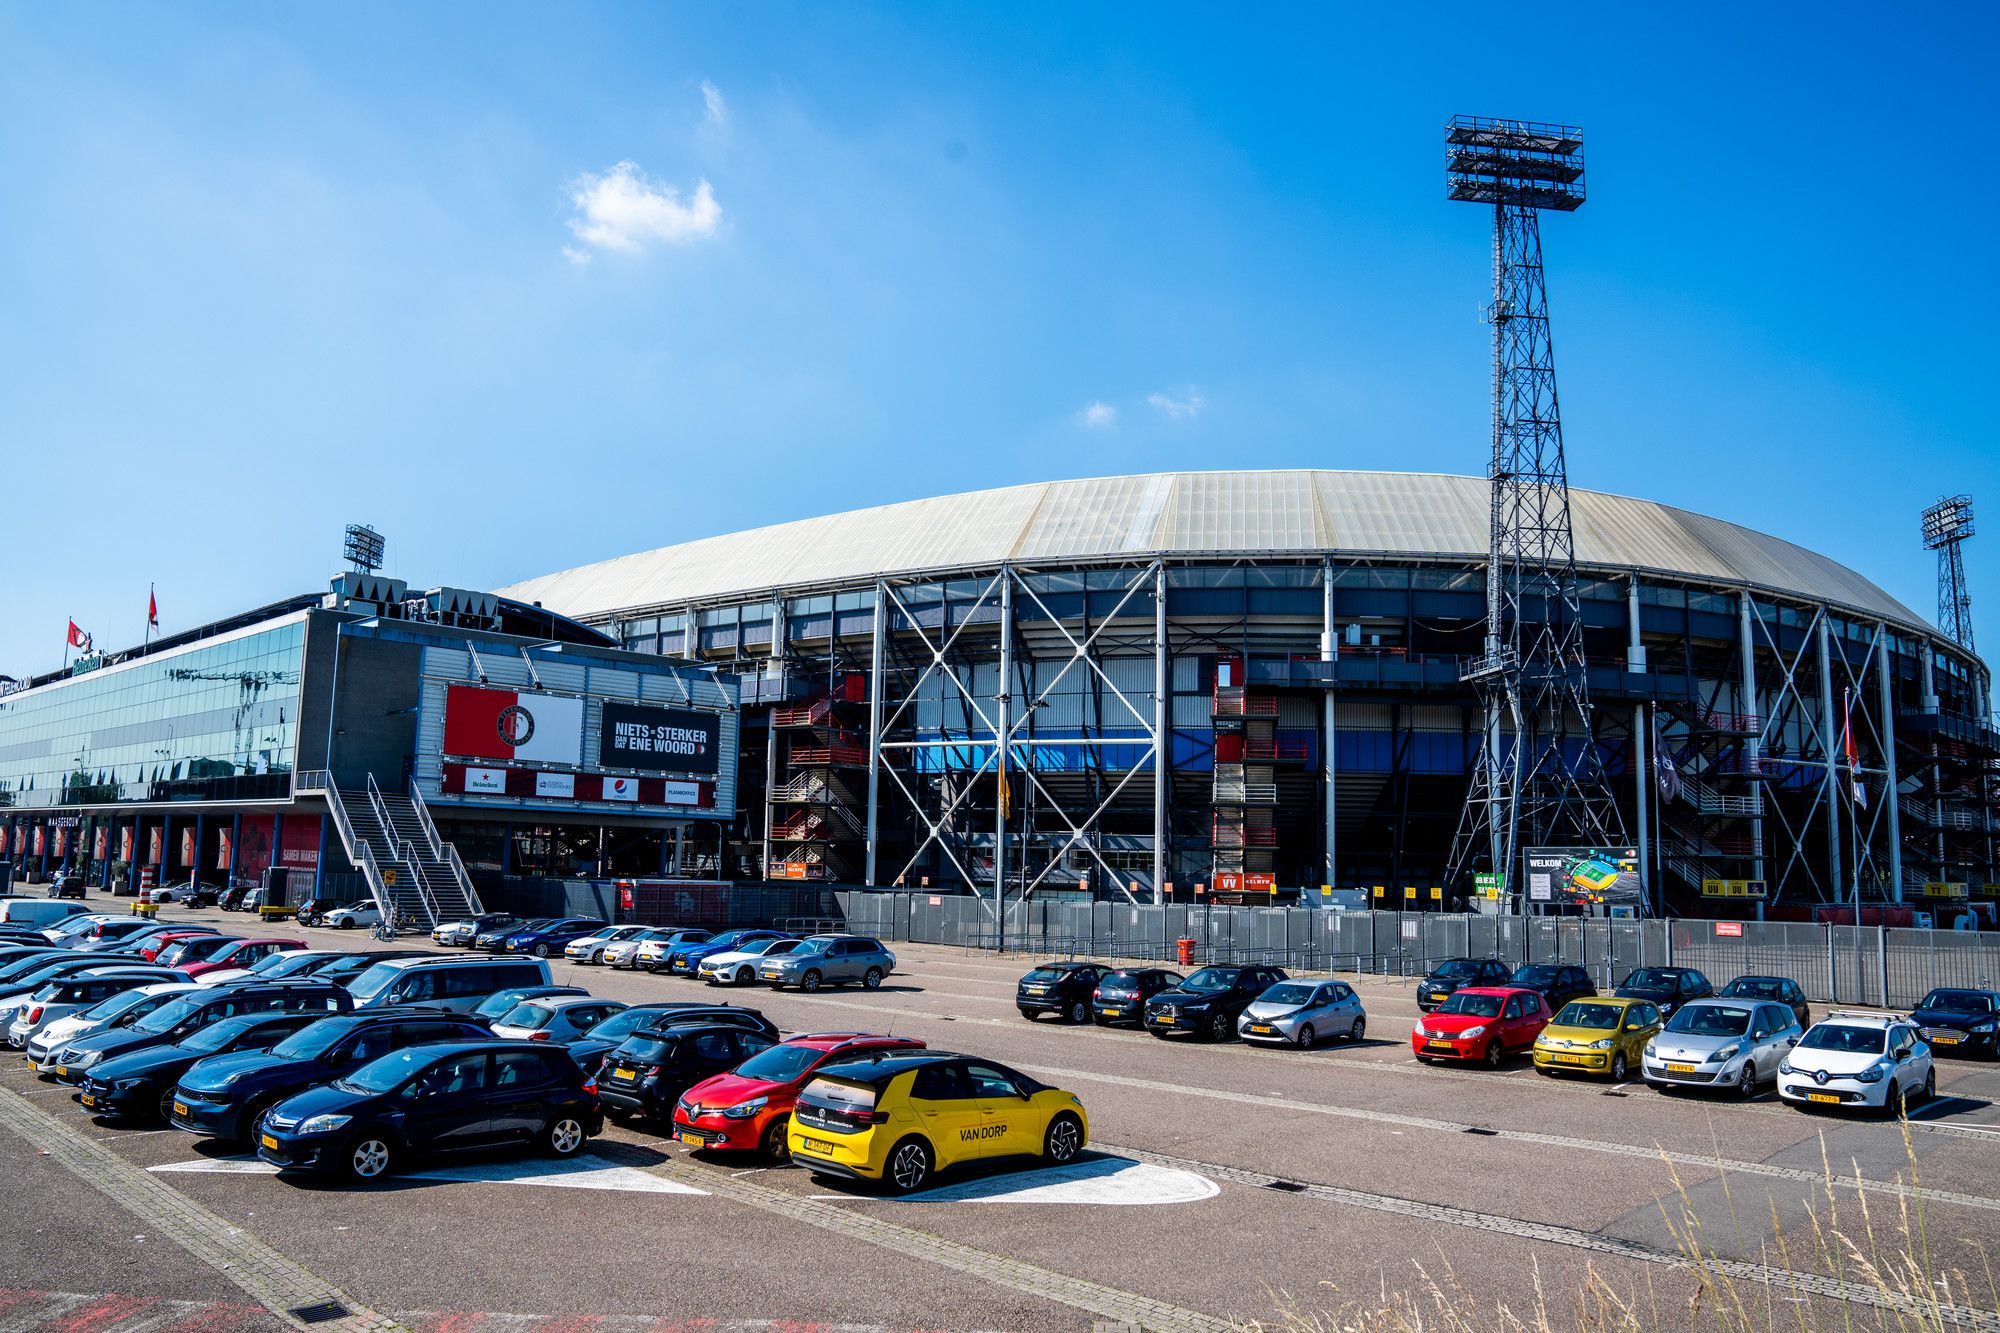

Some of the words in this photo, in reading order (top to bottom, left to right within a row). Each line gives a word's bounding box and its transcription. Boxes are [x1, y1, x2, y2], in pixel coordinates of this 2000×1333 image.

[72, 655, 100, 676] Heineken
[615, 722, 649, 738] NIETS
[656, 726, 707, 743] STERKER
[615, 741, 626, 749] DAT
[629, 737, 652, 751] ENE
[653, 739, 695, 755] WOORD
[48, 816, 79, 827] MAASGEBOUW
[1530, 859, 1562, 868] WELKOM
[1222, 878, 1236, 889] VV
[1707, 885, 1719, 894] UU
[1732, 886, 1742, 894] UU
[960, 1128, 979, 1141] VAN
[981, 1125, 1007, 1139] DORP
